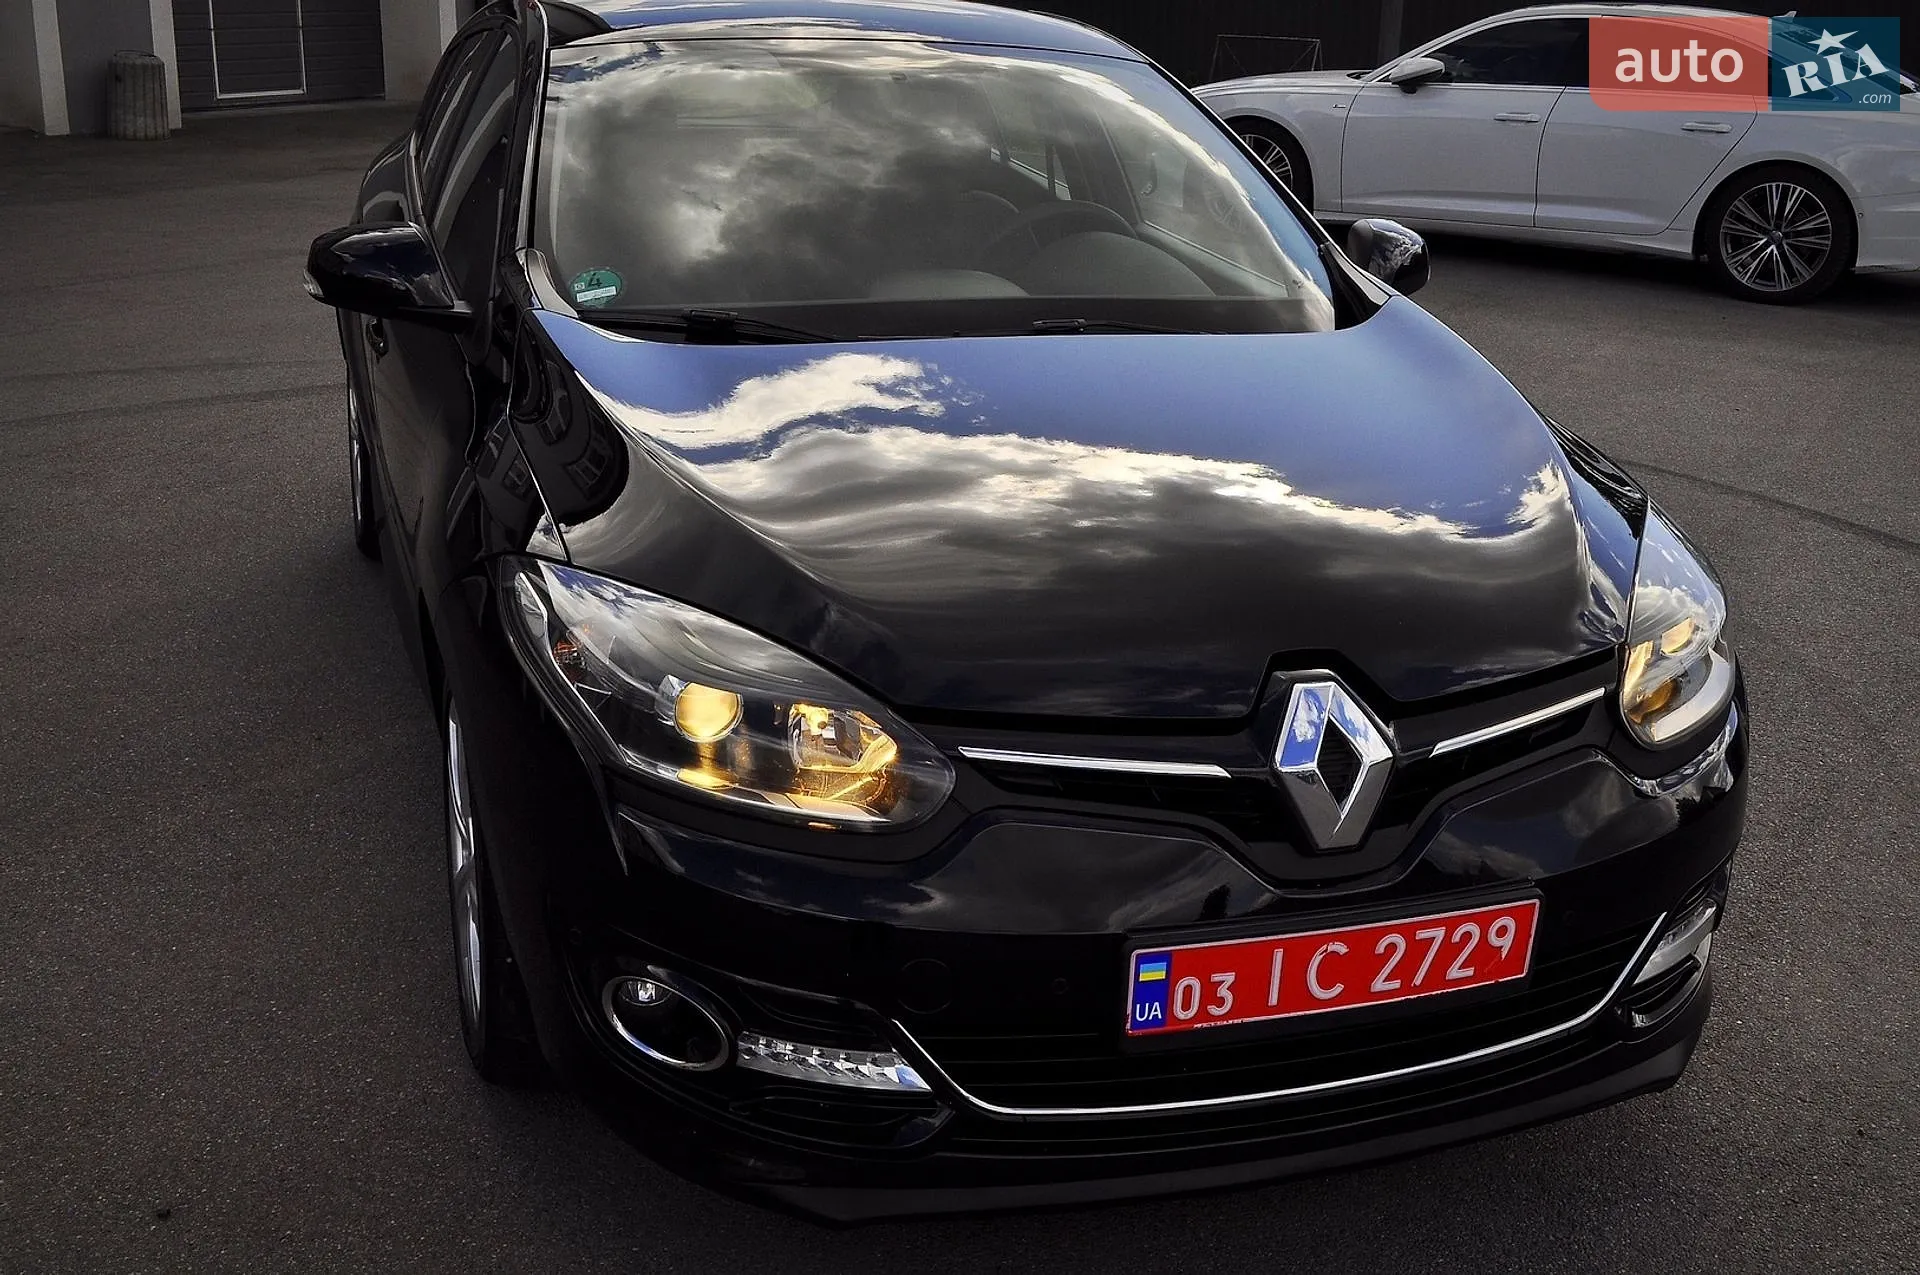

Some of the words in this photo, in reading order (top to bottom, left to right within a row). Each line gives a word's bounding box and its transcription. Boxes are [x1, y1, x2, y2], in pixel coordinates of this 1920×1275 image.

[588, 272, 603, 287] 4
[1173, 972, 1236, 1020] 03
[1370, 916, 1516, 993] 2729
[1136, 1001, 1162, 1022] UA
